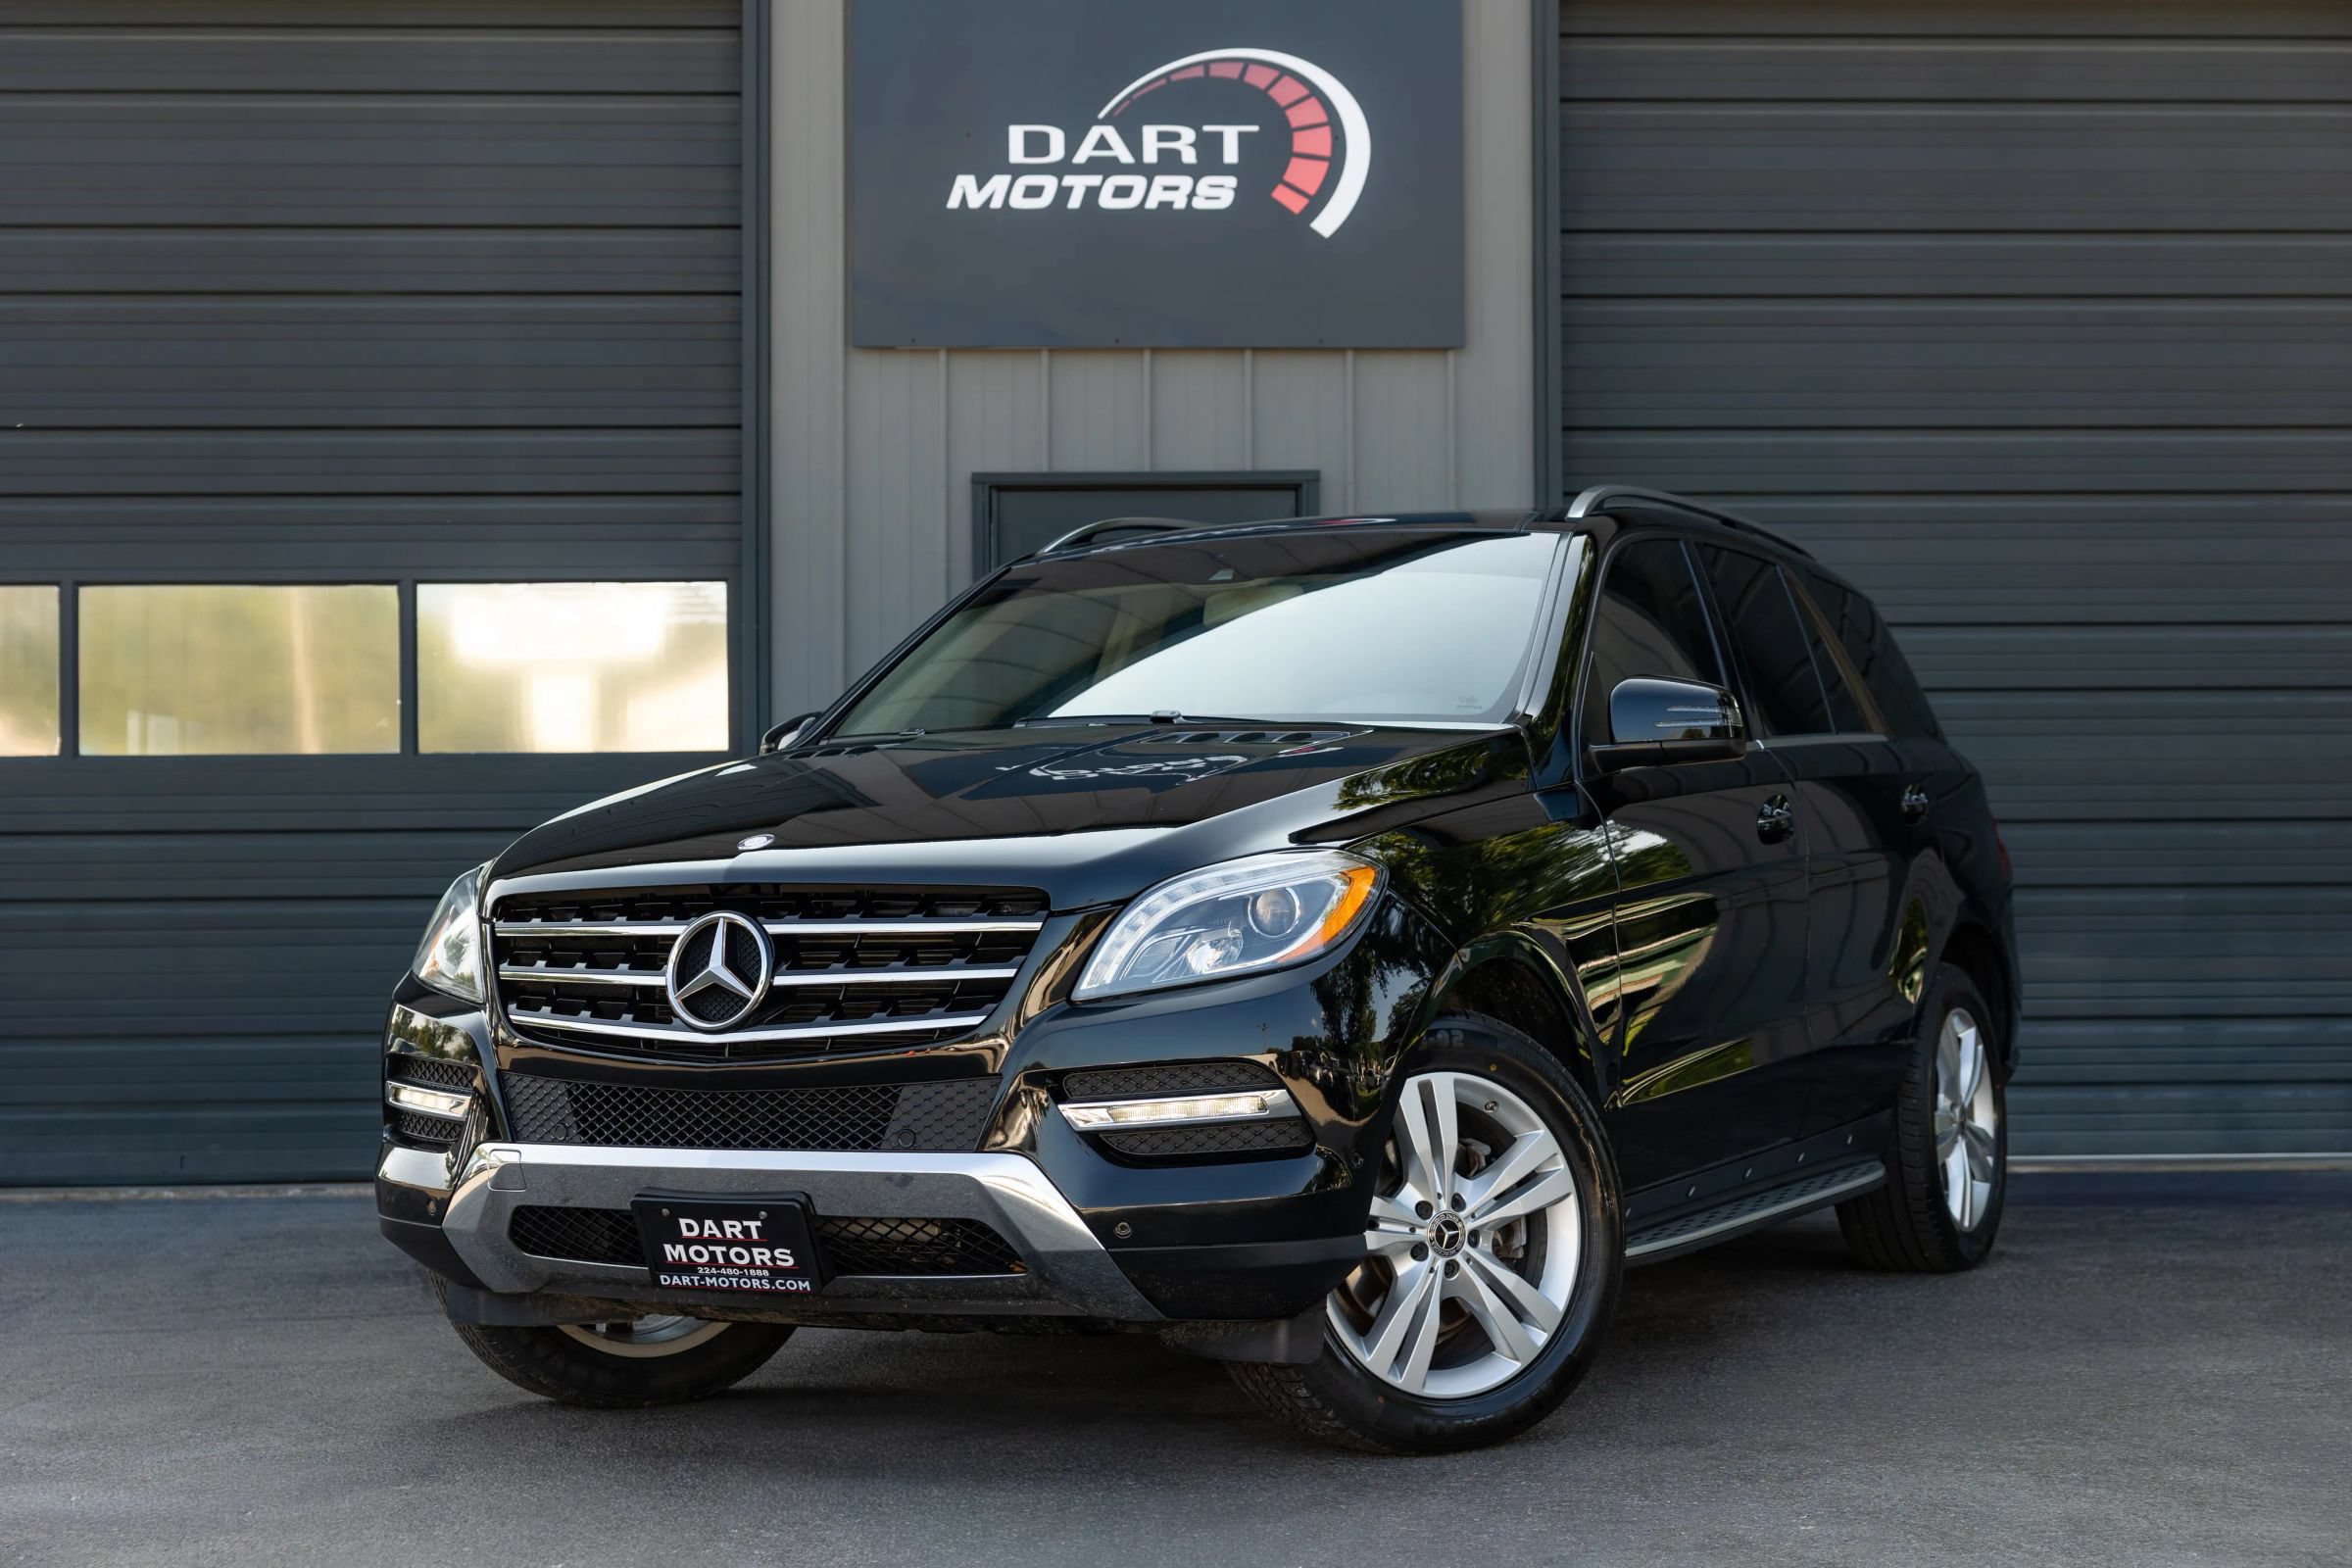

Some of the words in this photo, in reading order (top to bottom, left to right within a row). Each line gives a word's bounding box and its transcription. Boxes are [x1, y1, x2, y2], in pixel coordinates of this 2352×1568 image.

[1007, 124, 1260, 165] DART
[946, 173, 1238, 210] MOTORS
[678, 1218, 762, 1240] DART
[662, 1244, 795, 1266] MOTORS
[697, 1266, 770, 1277] 224-480-1888
[660, 1274, 810, 1292] DART-MOTORS.COM
